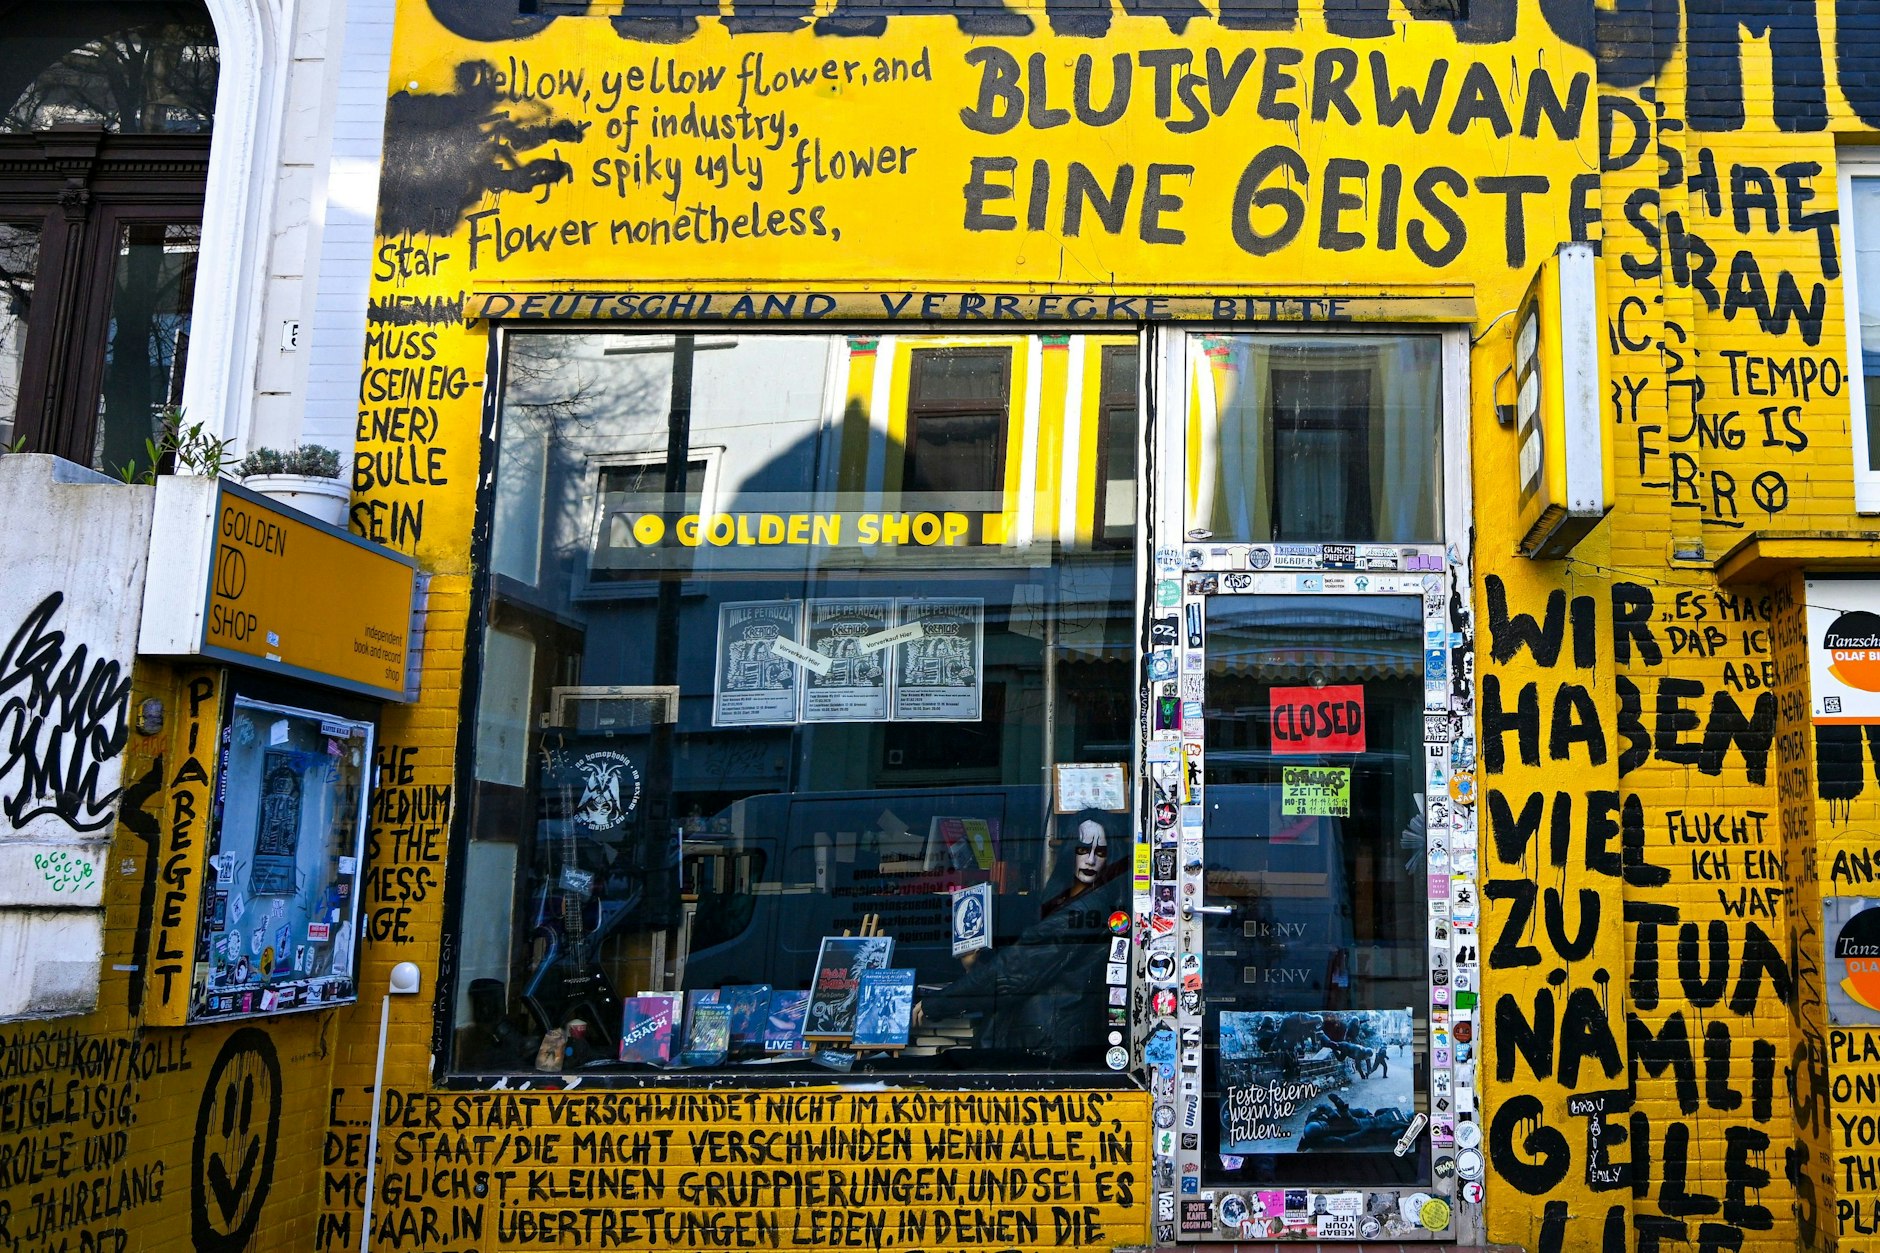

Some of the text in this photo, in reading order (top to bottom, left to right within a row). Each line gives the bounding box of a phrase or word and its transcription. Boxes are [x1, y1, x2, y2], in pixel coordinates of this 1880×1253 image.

[596, 56, 726, 113] yellow
[606, 105, 641, 152] of
[651, 103, 799, 148] industry,
[592, 143, 682, 201] spiky
[695, 150, 763, 192] ugly
[790, 138, 918, 194] flower
[963, 156, 1196, 246] EINE
[466, 202, 842, 271] Flower nonetheless,
[374, 243, 450, 283] Star
[481, 293, 838, 319] DEUTSCHLAND
[1211, 297, 1354, 322] BITTE
[365, 330, 438, 361] MUSS
[356, 406, 439, 444] ENER)
[1758, 405, 1808, 452] IS
[352, 445, 447, 492] BULLE
[222, 506, 287, 557] GOLDEN
[350, 499, 423, 545] SEIN
[676, 512, 969, 547] GOLDEN SHOP
[211, 604, 257, 643] SHOP
[729, 608, 752, 628] MILLE
[742, 624, 779, 639] KREATOR
[816, 605, 842, 625] MILLE
[831, 621, 870, 638] KREATOR
[1485, 574, 1663, 669] WIR
[354, 639, 402, 664] book and record
[364, 624, 402, 648] independent
[866, 631, 912, 649] Vorverkauf Hier
[779, 643, 820, 667] Vorverkauf Hier
[1835, 651, 1865, 661] OLAF
[385, 665, 400, 683] shop
[1273, 701, 1361, 741] CLOSED
[1481, 674, 1780, 786] HABEN
[585, 750, 631, 767] homophobia
[1289, 787, 1339, 797] ZEITEN
[1488, 790, 1671, 888] VIEL
[1666, 810, 1769, 845] FLUCHT
[1782, 805, 1810, 843] SUCHE
[391, 828, 441, 863] THE
[1691, 850, 1729, 881] ICH
[1484, 878, 1601, 969] ZU
[1624, 901, 1802, 1028] TUN
[623, 1016, 668, 1047] KRACH
[765, 1040, 793, 1050] LIVE
[1830, 1030, 1880, 1064] PLA
[0, 1077, 140, 1134] EIGLEISIG:
[385, 1089, 442, 1130] DER
[452, 1094, 540, 1130] STAAT
[547, 1094, 761, 1126] VERSCHWINDET
[766, 1094, 843, 1125] NICHT
[1227, 1079, 1319, 1107] Feste feiern
[1229, 1100, 1295, 1122] wenn sie
[84, 1130, 128, 1172] UND
[573, 1129, 674, 1166] MACHT
[688, 1126, 912, 1165] VERSCHWINDEN
[924, 1128, 1002, 1164] WENN
[27, 1160, 166, 1243] JAHRELANG
[528, 1167, 665, 1204] KLEINEN
[967, 1167, 1027, 1206] UND
[1032, 1166, 1081, 1202] SEI
[1096, 1170, 1135, 1208] ES
[316, 1212, 351, 1251] IM
[499, 1199, 779, 1247] ÜBERTRETUNGEN
[933, 1205, 1038, 1246] DENEN
[1052, 1206, 1106, 1247] DIE
[1186, 1212, 1208, 1221] KANTE
[1187, 1203, 1206, 1212] ROTE
[1181, 1222, 1201, 1230] GEGEN
